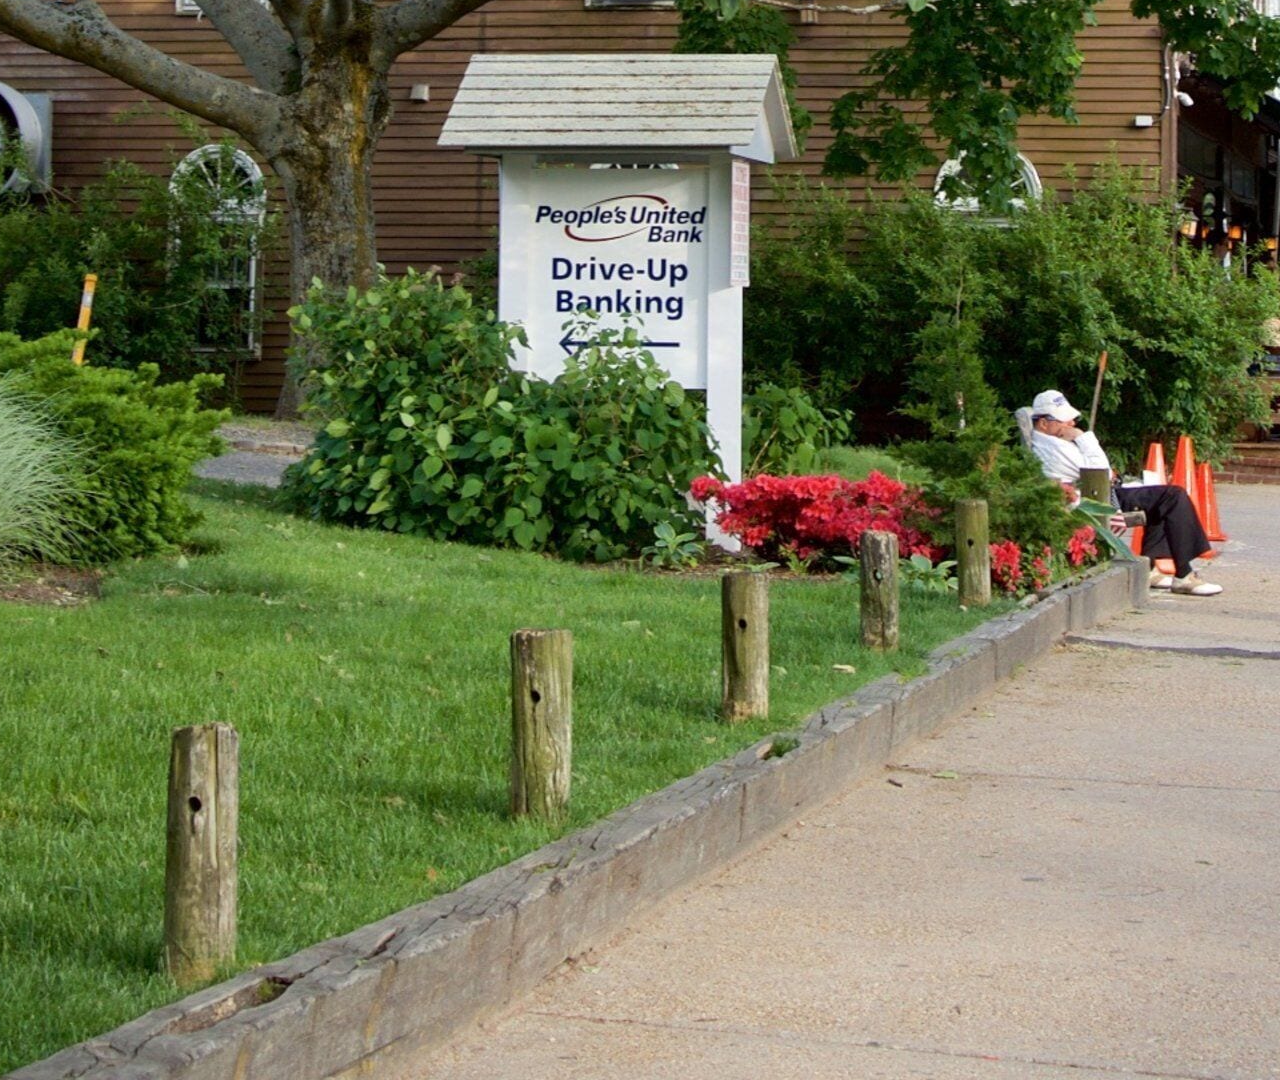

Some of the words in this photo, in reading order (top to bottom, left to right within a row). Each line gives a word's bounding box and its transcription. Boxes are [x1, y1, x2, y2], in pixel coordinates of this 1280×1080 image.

[535, 205, 627, 228] People's
[630, 205, 707, 224] United
[648, 226, 703, 243] Bank
[552, 256, 689, 288] Drive-Up
[556, 289, 683, 320] Banking
